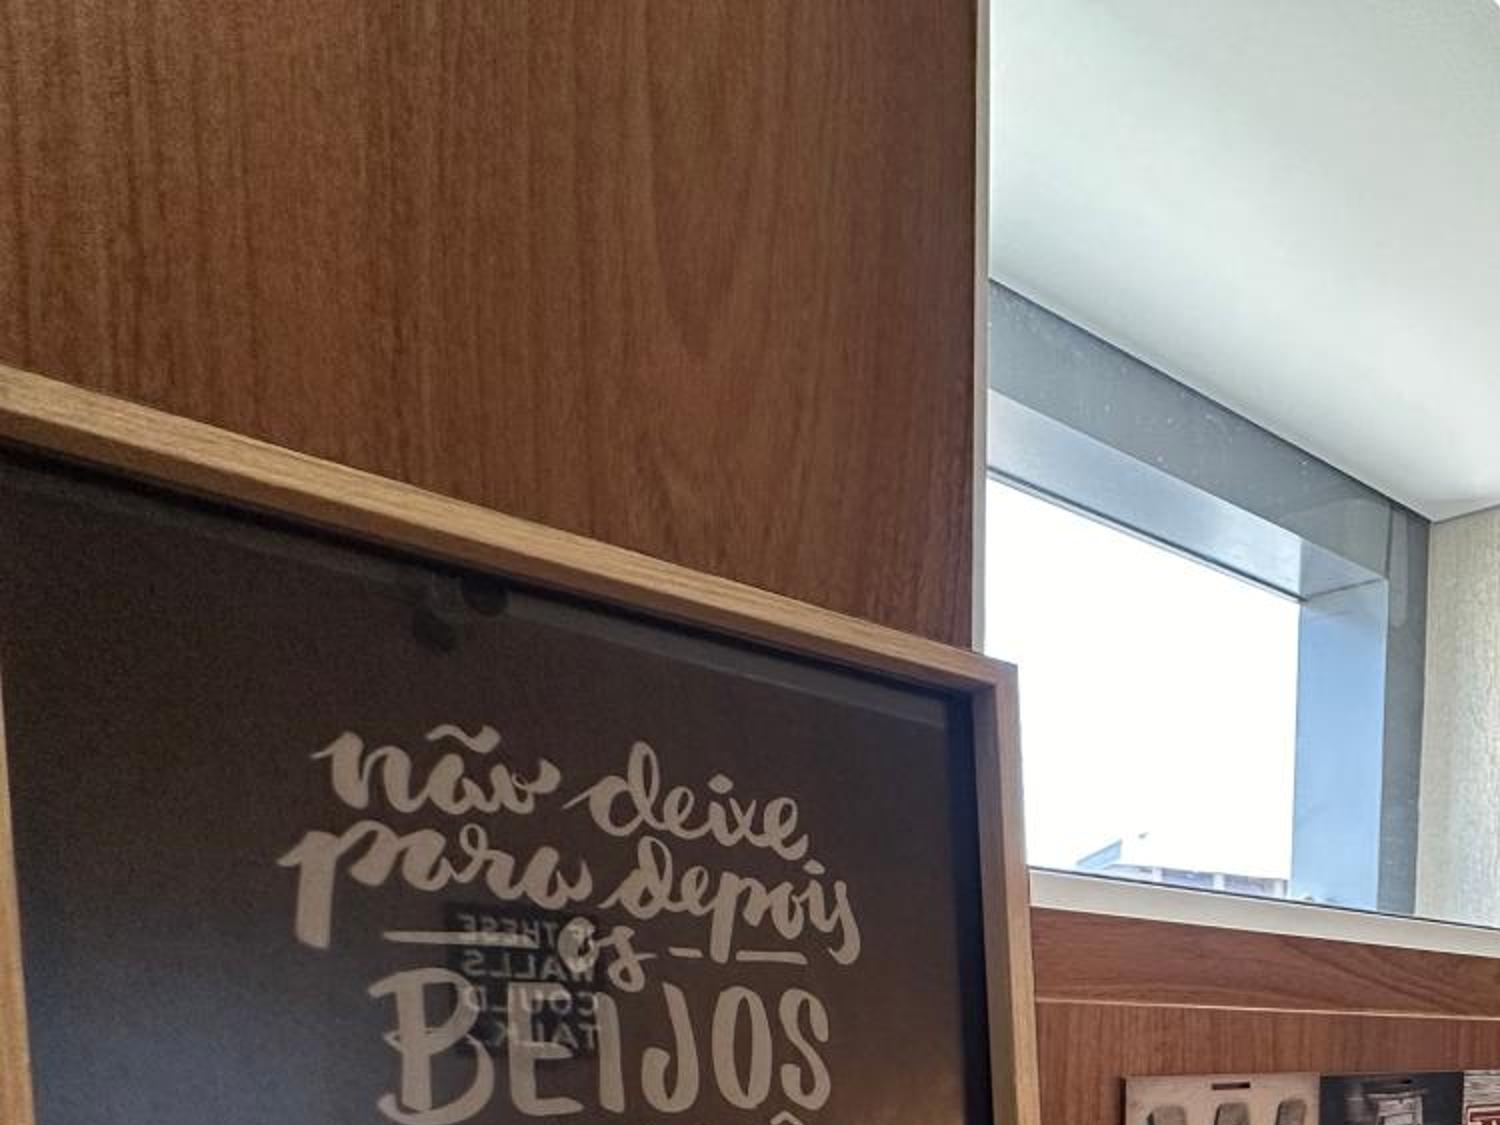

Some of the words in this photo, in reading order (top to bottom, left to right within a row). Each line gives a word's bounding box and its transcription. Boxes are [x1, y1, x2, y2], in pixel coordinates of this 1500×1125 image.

[313, 726, 561, 814] não
[564, 741, 809, 860] deixe
[278, 820, 592, 948] para
[599, 838, 861, 963] depois
[557, 917, 656, 991] os
